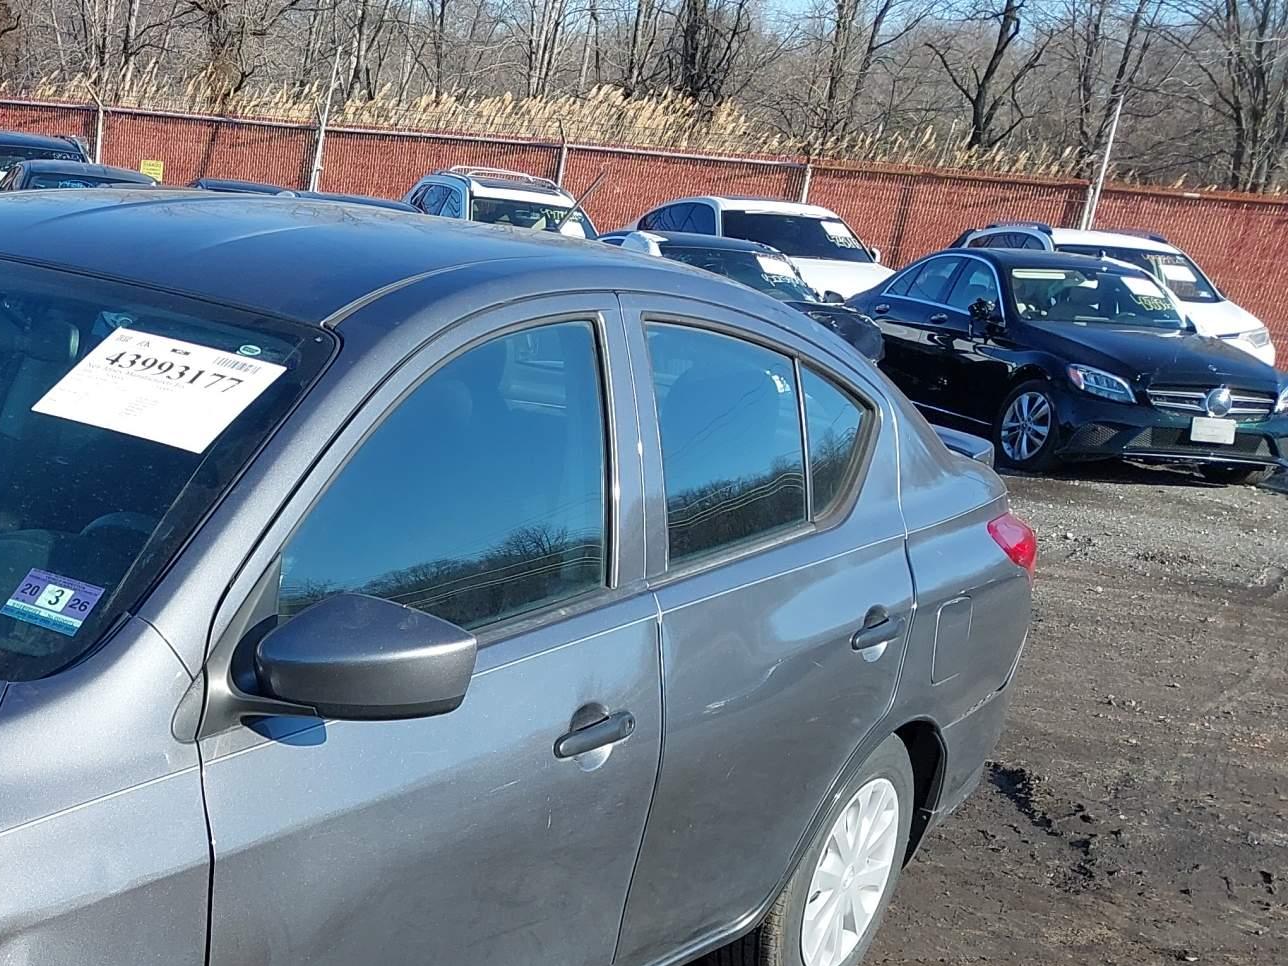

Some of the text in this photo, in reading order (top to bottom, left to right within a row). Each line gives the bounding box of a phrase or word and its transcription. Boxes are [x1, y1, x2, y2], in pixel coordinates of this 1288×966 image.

[105, 351, 244, 392] 43993177
[21, 583, 40, 597] 20
[48, 589, 65, 606] 3
[68, 598, 90, 612] 26
